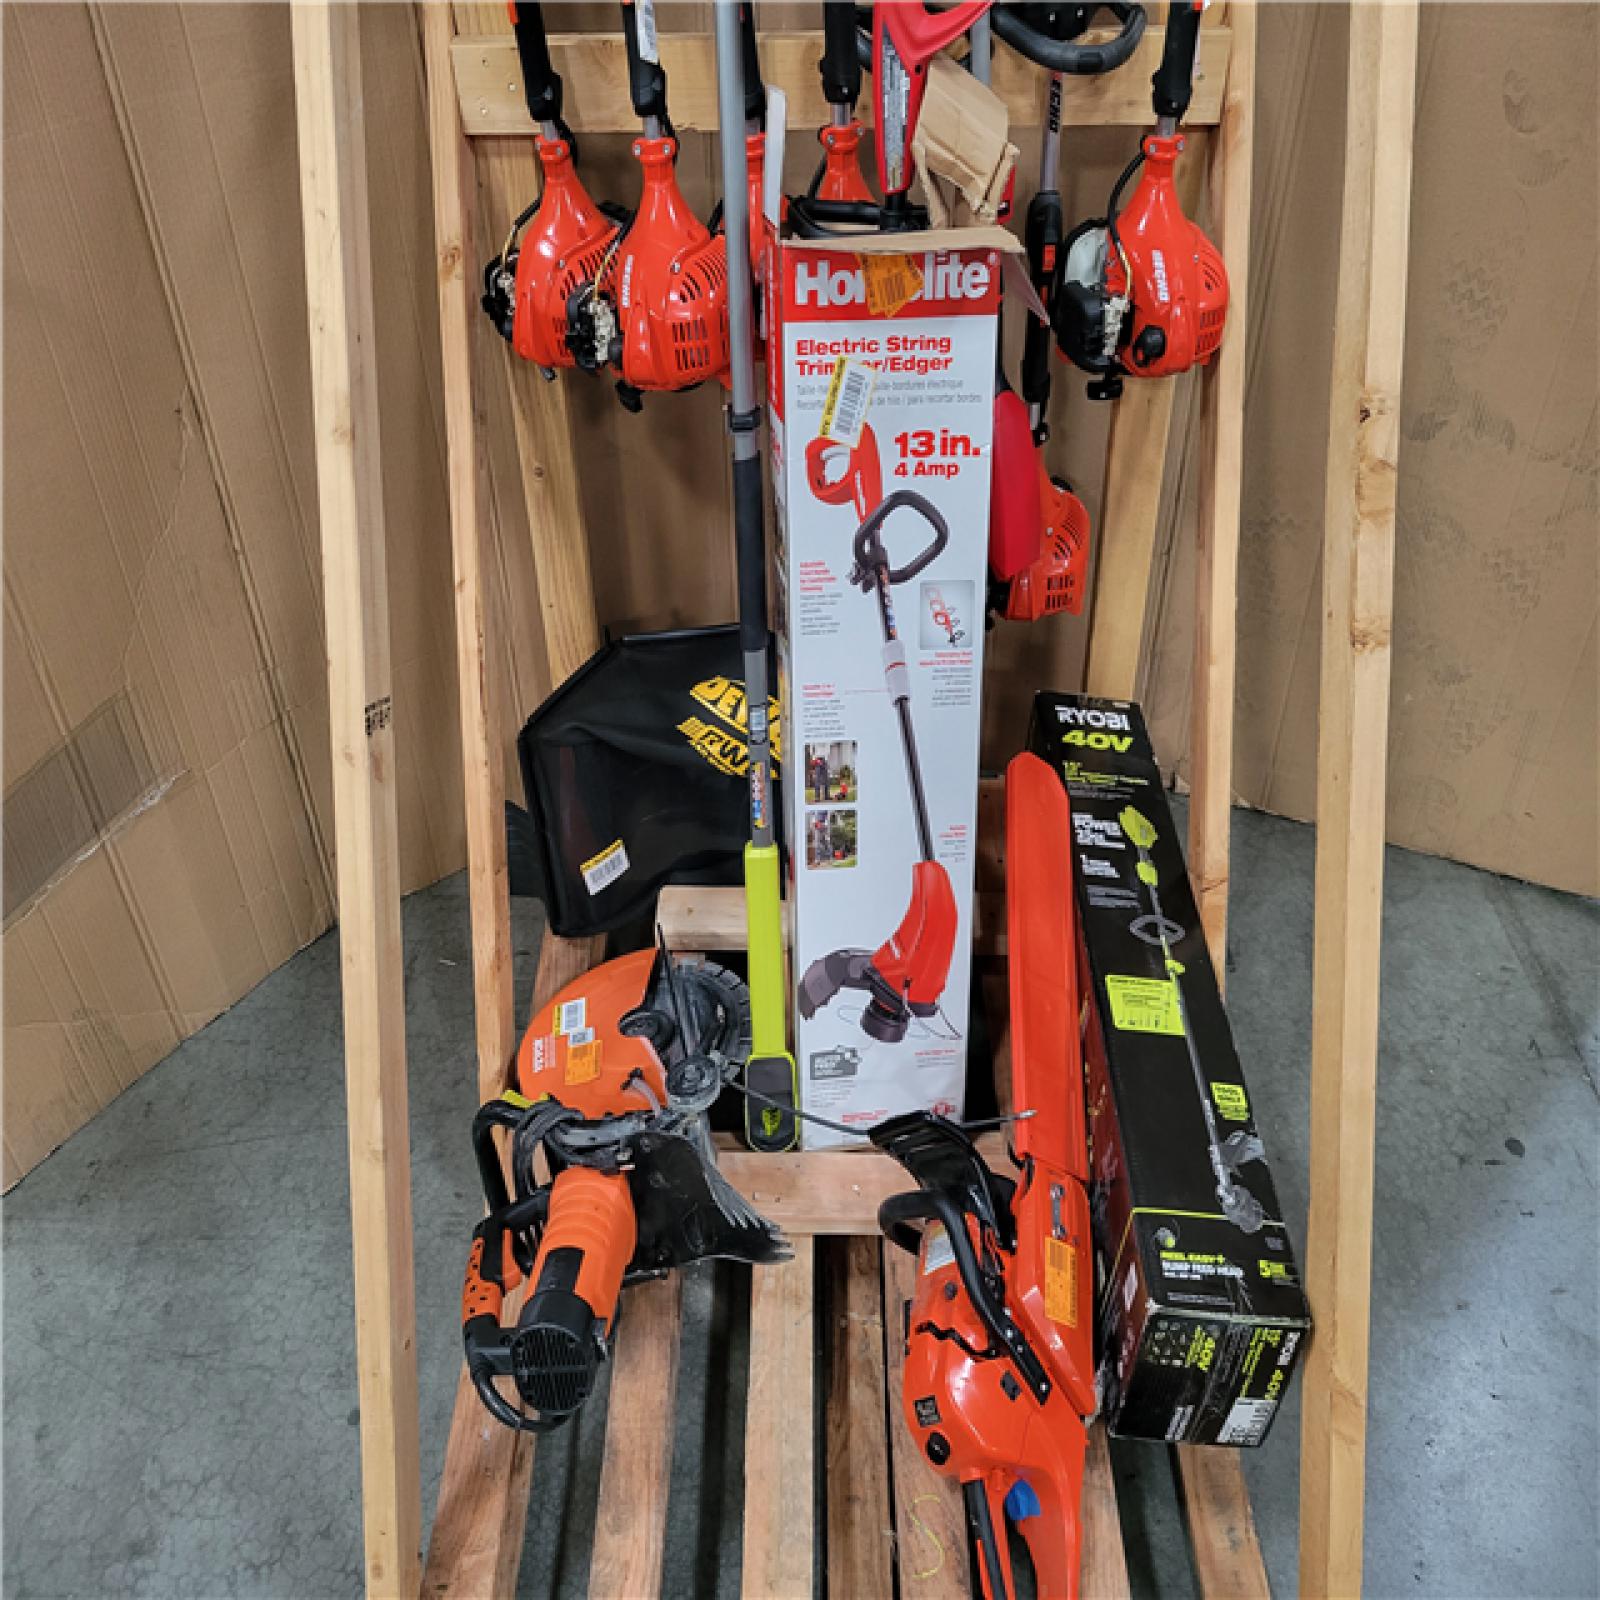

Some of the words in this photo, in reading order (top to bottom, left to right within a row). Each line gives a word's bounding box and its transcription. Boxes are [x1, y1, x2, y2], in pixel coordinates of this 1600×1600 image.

[796, 337, 881, 356] Electric
[886, 335, 952, 354] String
[894, 429, 936, 458] 13
[940, 427, 981, 457] in.
[894, 461, 908, 477] 4
[914, 460, 960, 481] Amp
[1055, 704, 1130, 730] RYOBI
[1062, 729, 1133, 753] 40V
